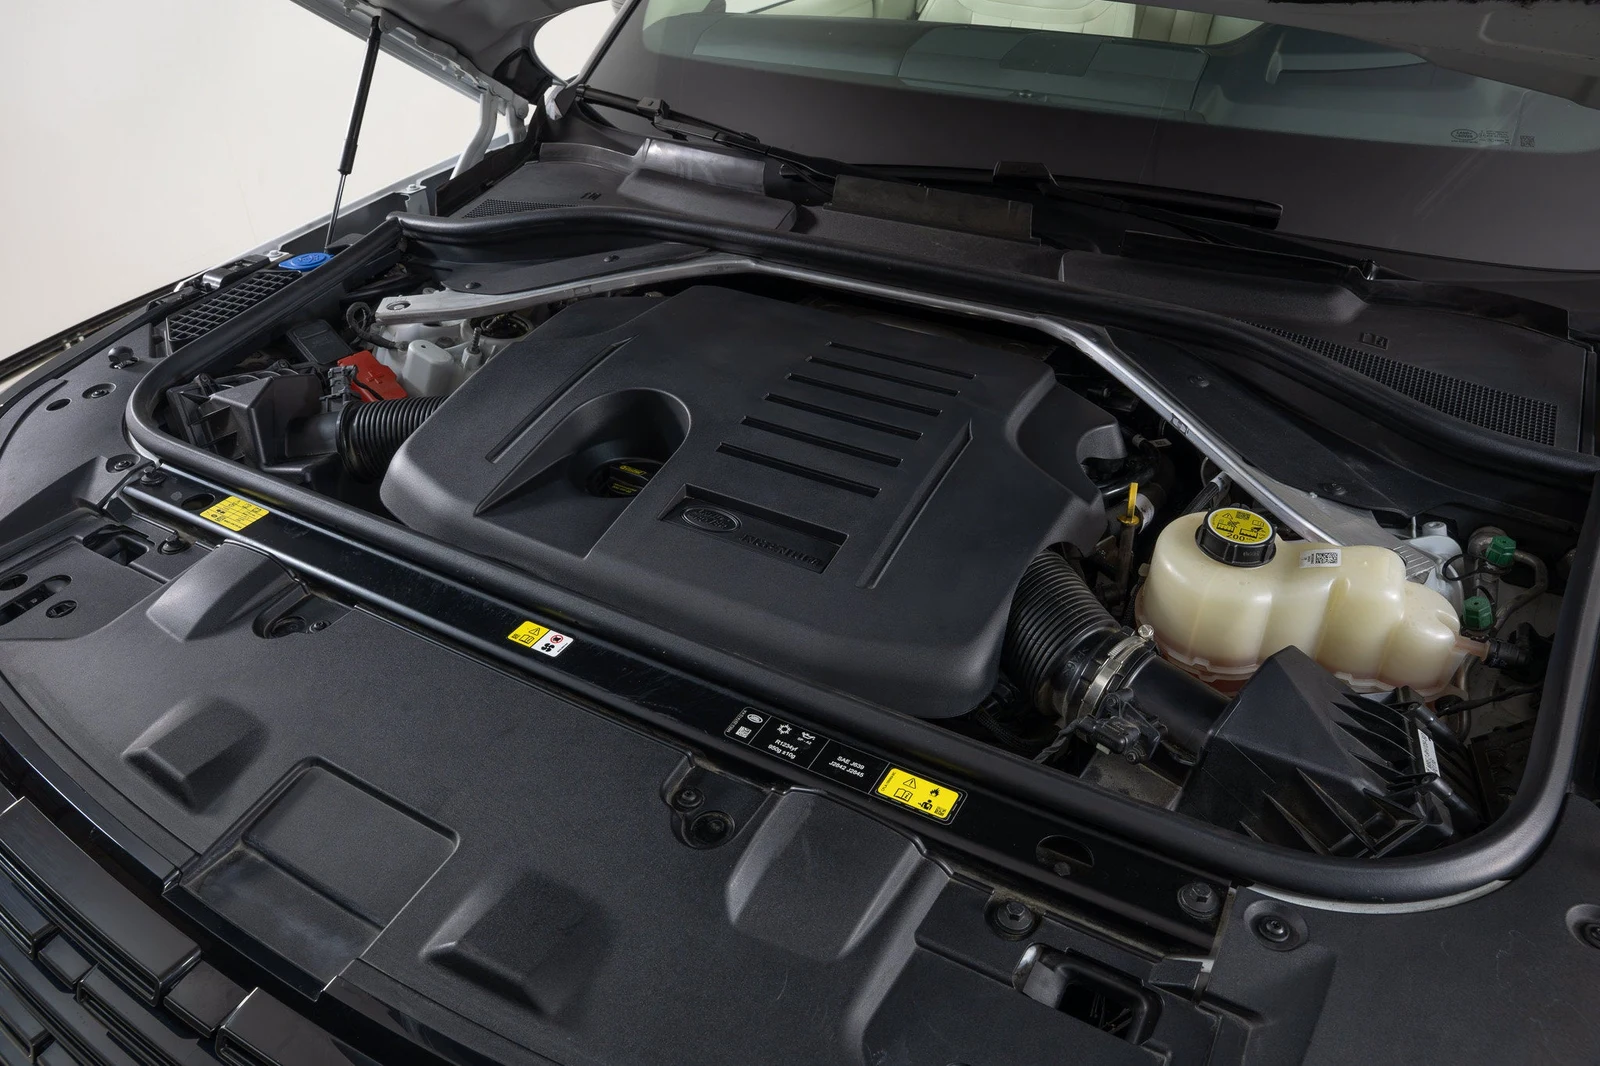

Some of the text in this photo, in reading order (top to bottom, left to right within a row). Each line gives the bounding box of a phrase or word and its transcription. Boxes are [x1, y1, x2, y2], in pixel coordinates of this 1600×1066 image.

[1226, 532, 1245, 542] 200
[774, 739, 799, 752] R1234yf
[837, 755, 850, 765] SAE
